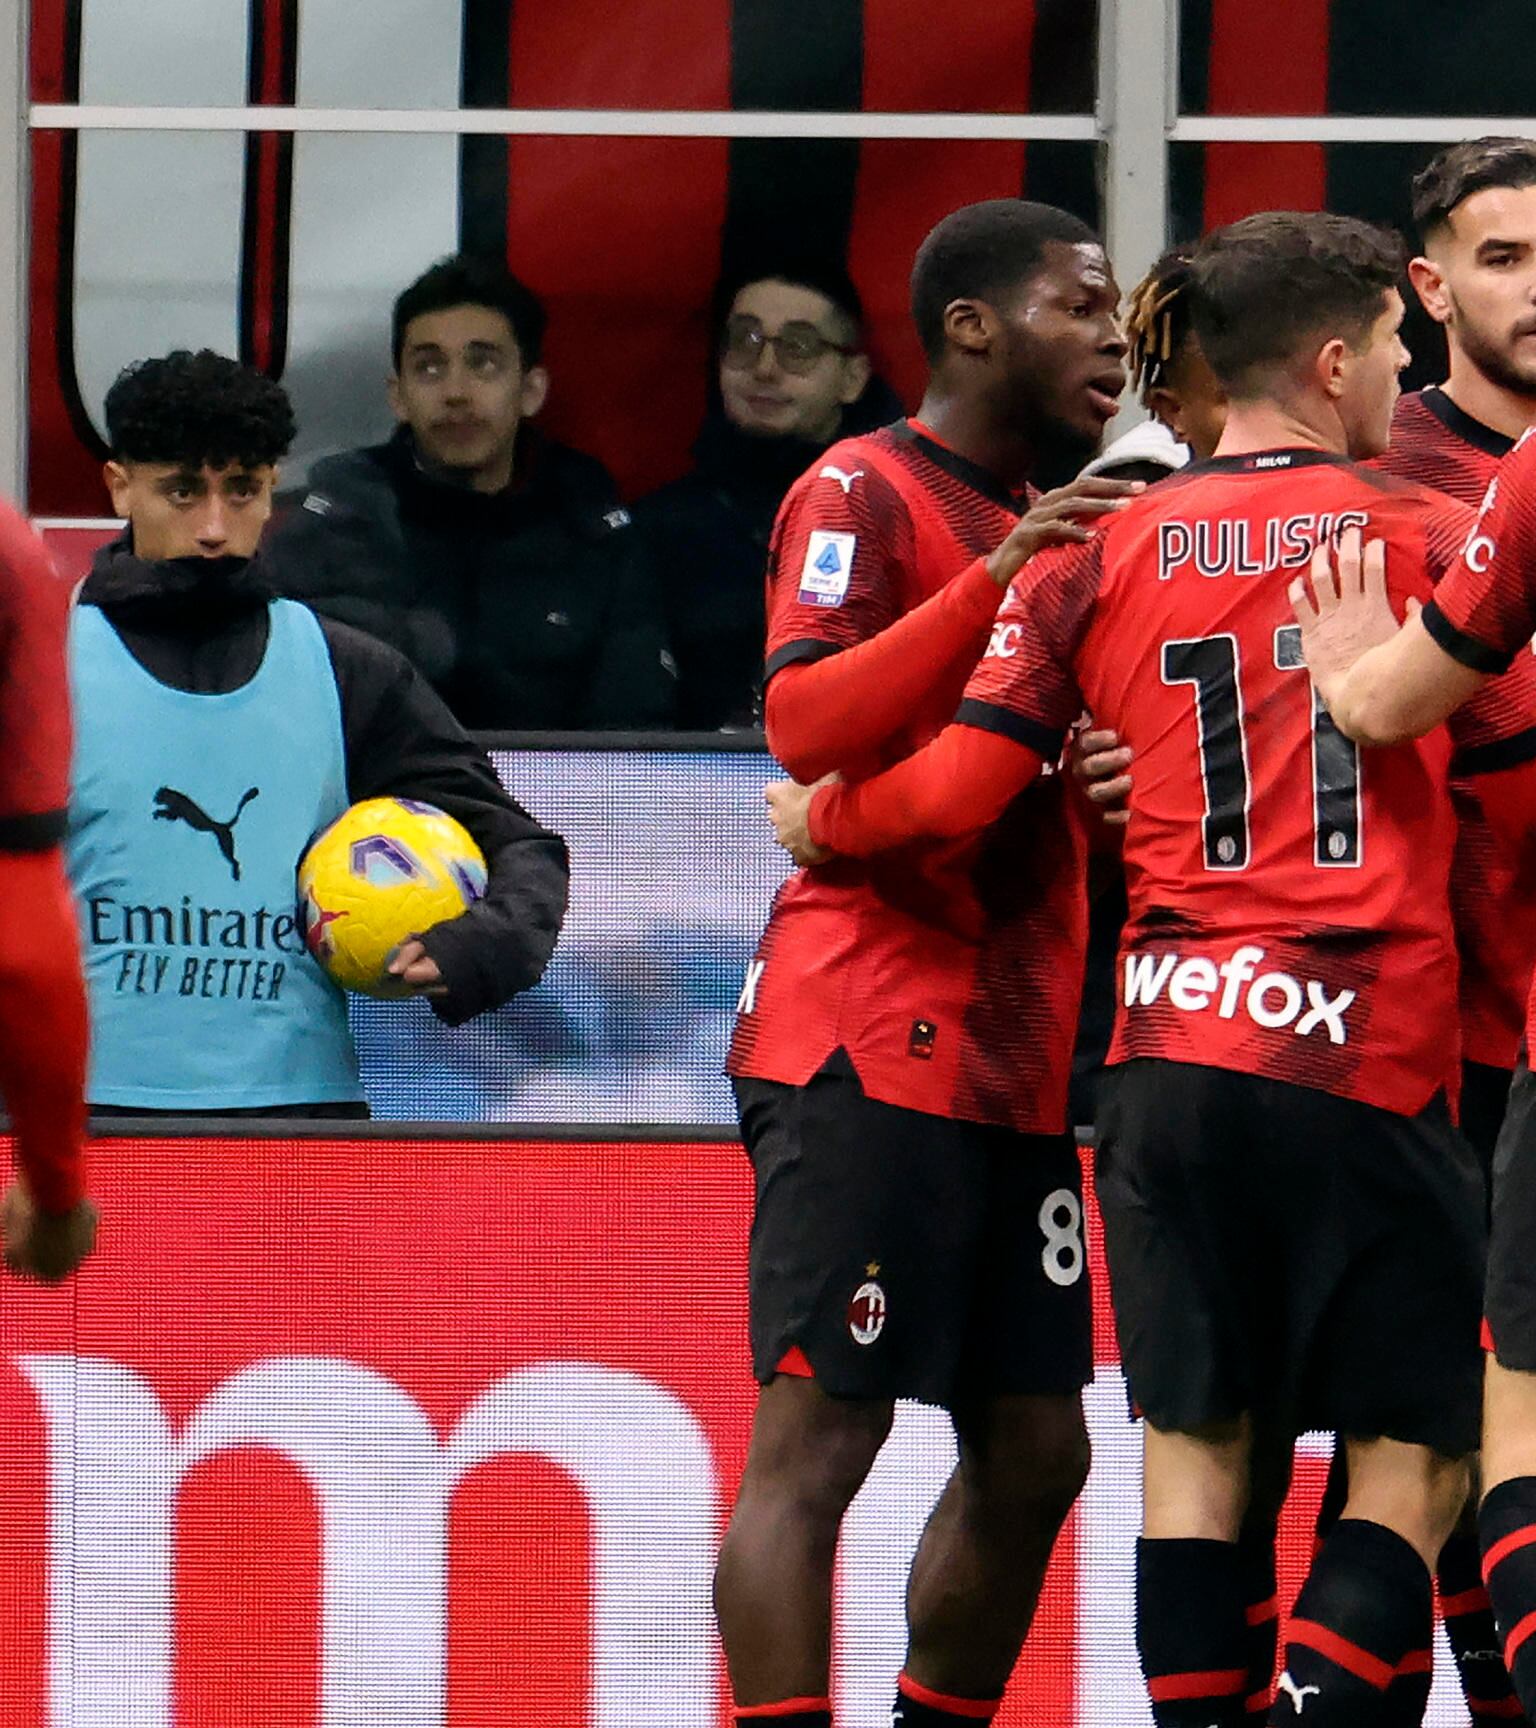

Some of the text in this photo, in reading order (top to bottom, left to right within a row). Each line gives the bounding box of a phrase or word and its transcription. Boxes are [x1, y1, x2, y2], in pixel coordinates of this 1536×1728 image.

[1161, 625, 1362, 871] 11
[116, 951, 286, 1001] FLY BETTER
[1124, 946, 1356, 1046] wefox
[1038, 1188, 1083, 1287] 8
